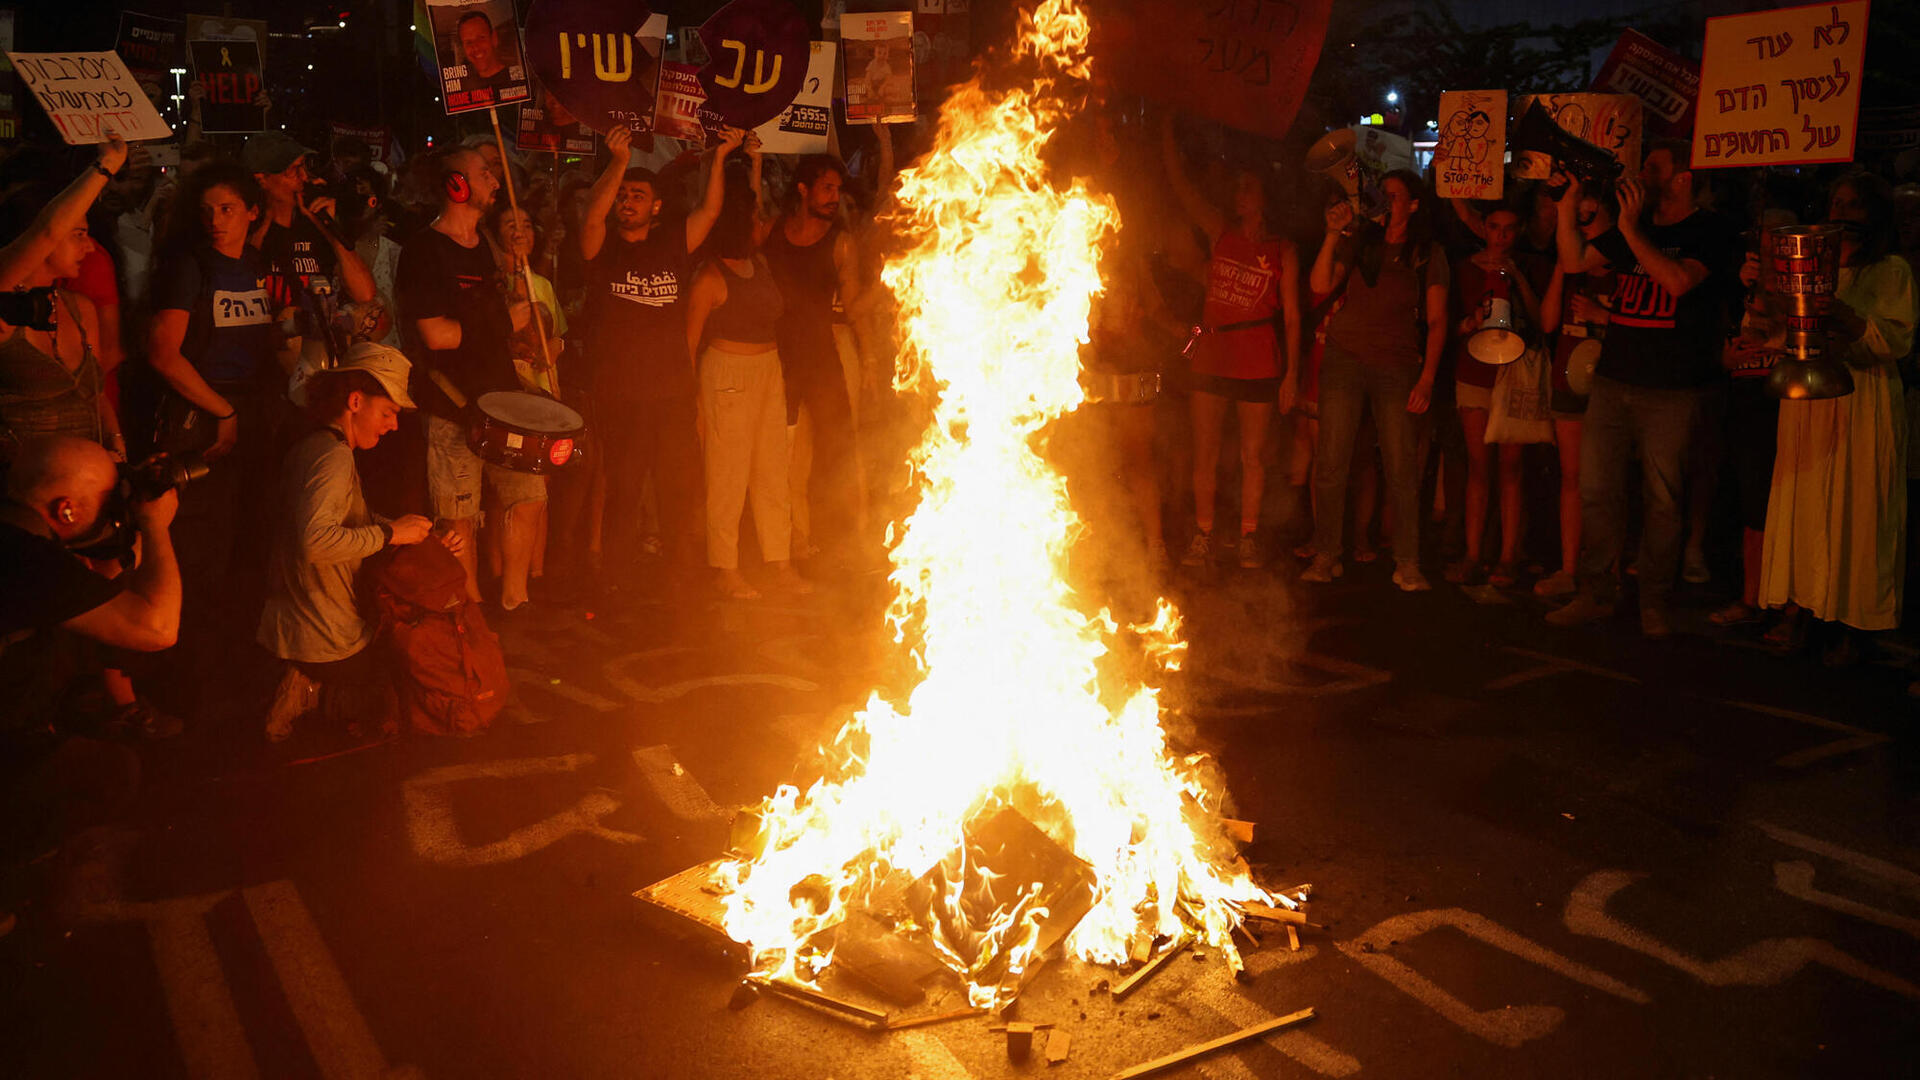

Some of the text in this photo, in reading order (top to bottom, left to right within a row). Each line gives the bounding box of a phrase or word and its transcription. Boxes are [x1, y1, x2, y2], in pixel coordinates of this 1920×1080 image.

[1746, 6, 1850, 60] לא עוד
[16, 56, 122, 85] מסרבות
[560, 31, 633, 83] שיו
[443, 64, 468, 81] BRING
[445, 79, 461, 93] HIM
[1714, 58, 1851, 115] לניסוך הדם
[40, 84, 133, 112] לממשלת
[199, 72, 260, 105] HELP
[1704, 128, 1790, 158] החטופים
[1801, 114, 1841, 152] של
[610, 282, 678, 296] עומדים ביחד
